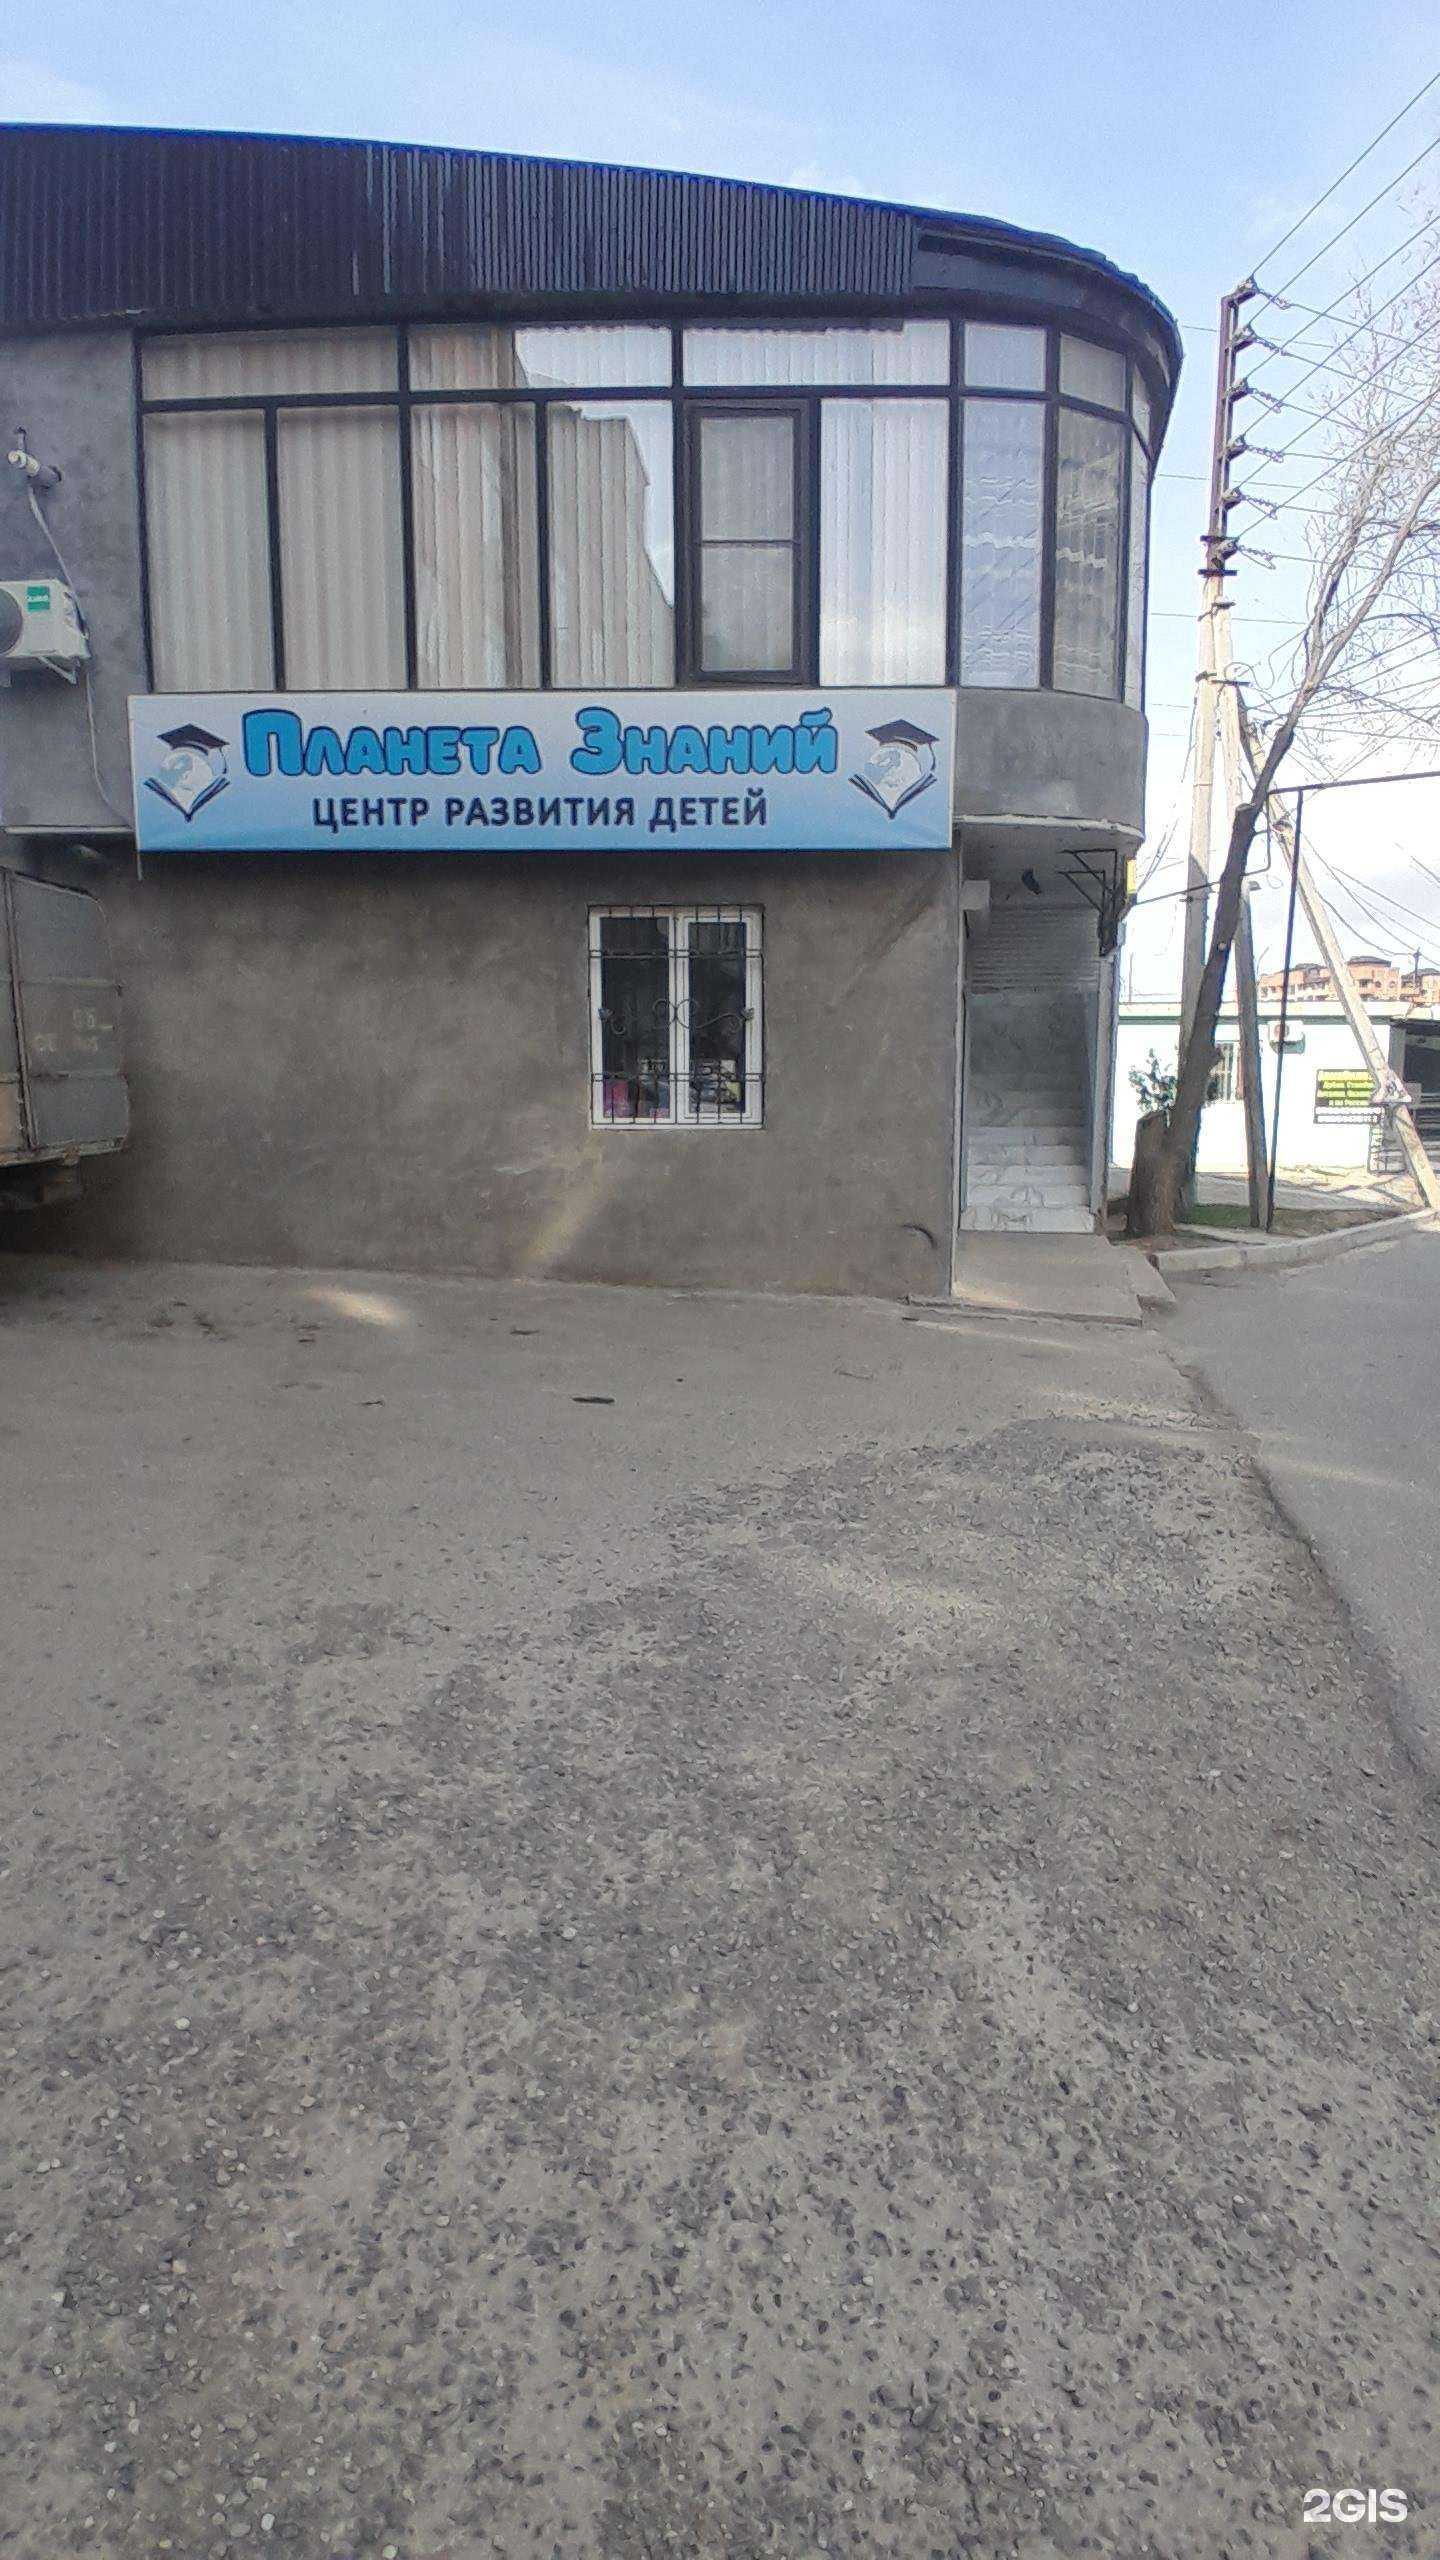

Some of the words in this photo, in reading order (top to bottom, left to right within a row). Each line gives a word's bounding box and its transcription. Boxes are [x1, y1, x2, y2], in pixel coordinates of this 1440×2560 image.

[313, 798, 430, 834] ЦЕНТР
[445, 797, 635, 827] РАЗВИТИЯ
[649, 788, 768, 834] ДЕТЕЙ
